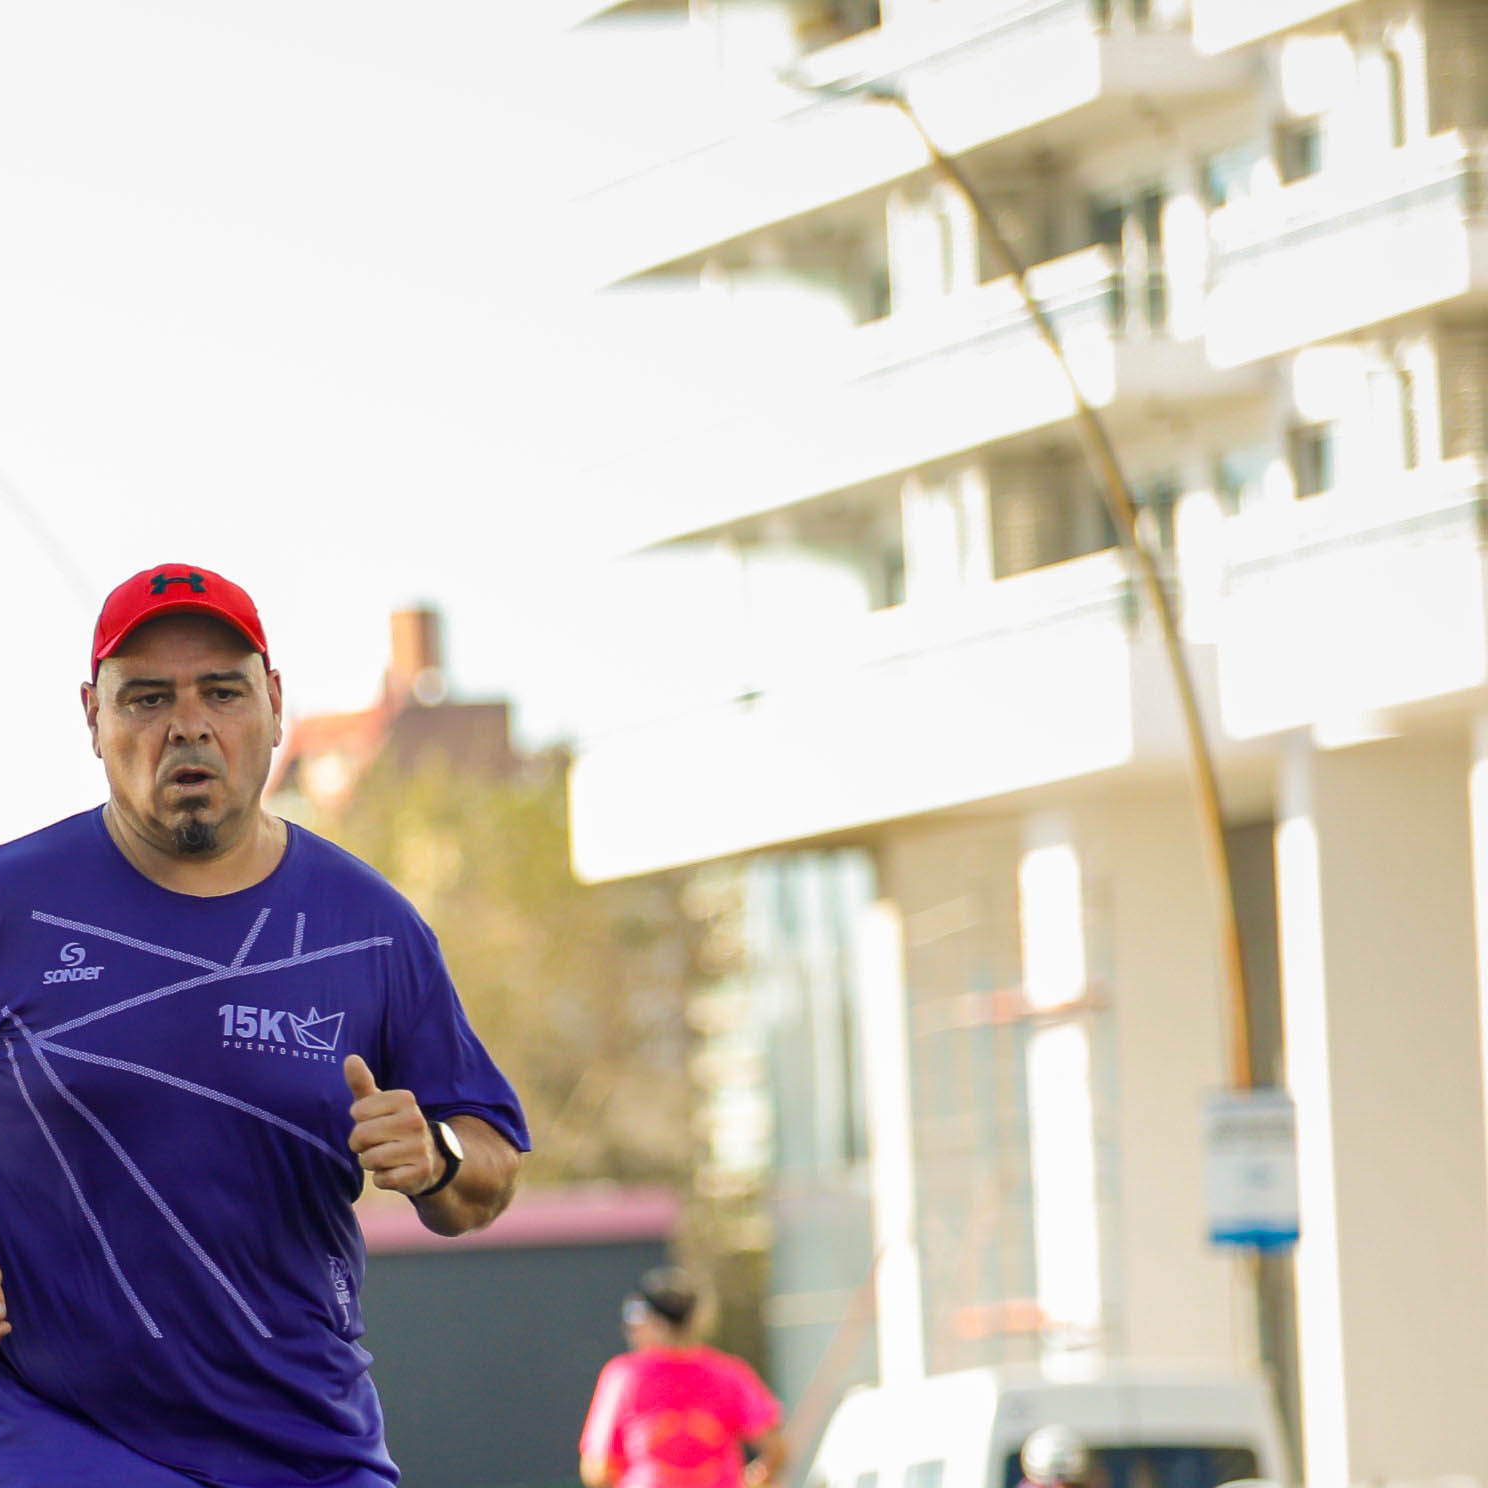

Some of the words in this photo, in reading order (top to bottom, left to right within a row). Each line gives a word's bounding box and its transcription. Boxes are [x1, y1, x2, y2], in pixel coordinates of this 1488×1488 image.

[218, 1004, 286, 1043] 15K
[222, 1041, 286, 1055] PUERTO
[292, 1049, 337, 1064] NORTE
